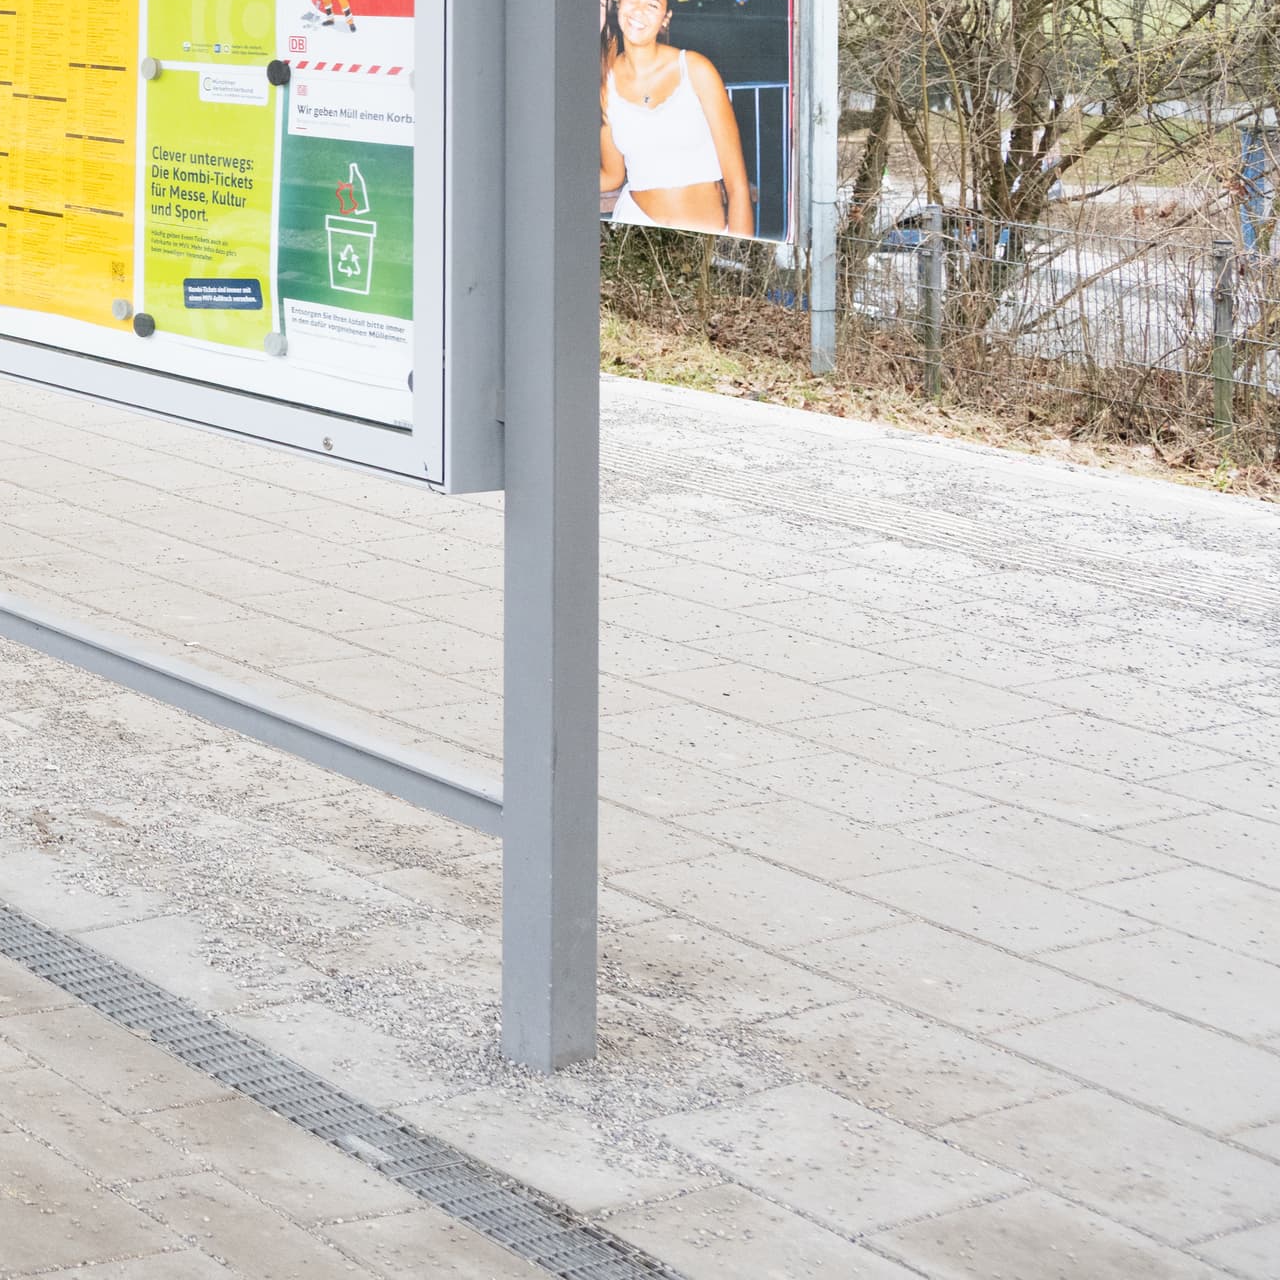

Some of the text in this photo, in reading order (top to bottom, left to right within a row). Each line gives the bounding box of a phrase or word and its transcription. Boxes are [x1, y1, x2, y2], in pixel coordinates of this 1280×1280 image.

[292, 38, 305, 50] DB
[298, 105, 416, 123] Wir geben Müll einen Korb.
[152, 146, 254, 170] Clever unterwegs:
[152, 166, 253, 189] Die Kombi-Tickets
[152, 182, 246, 208] für Messe, Kultur
[152, 202, 208, 223] und Sport.
